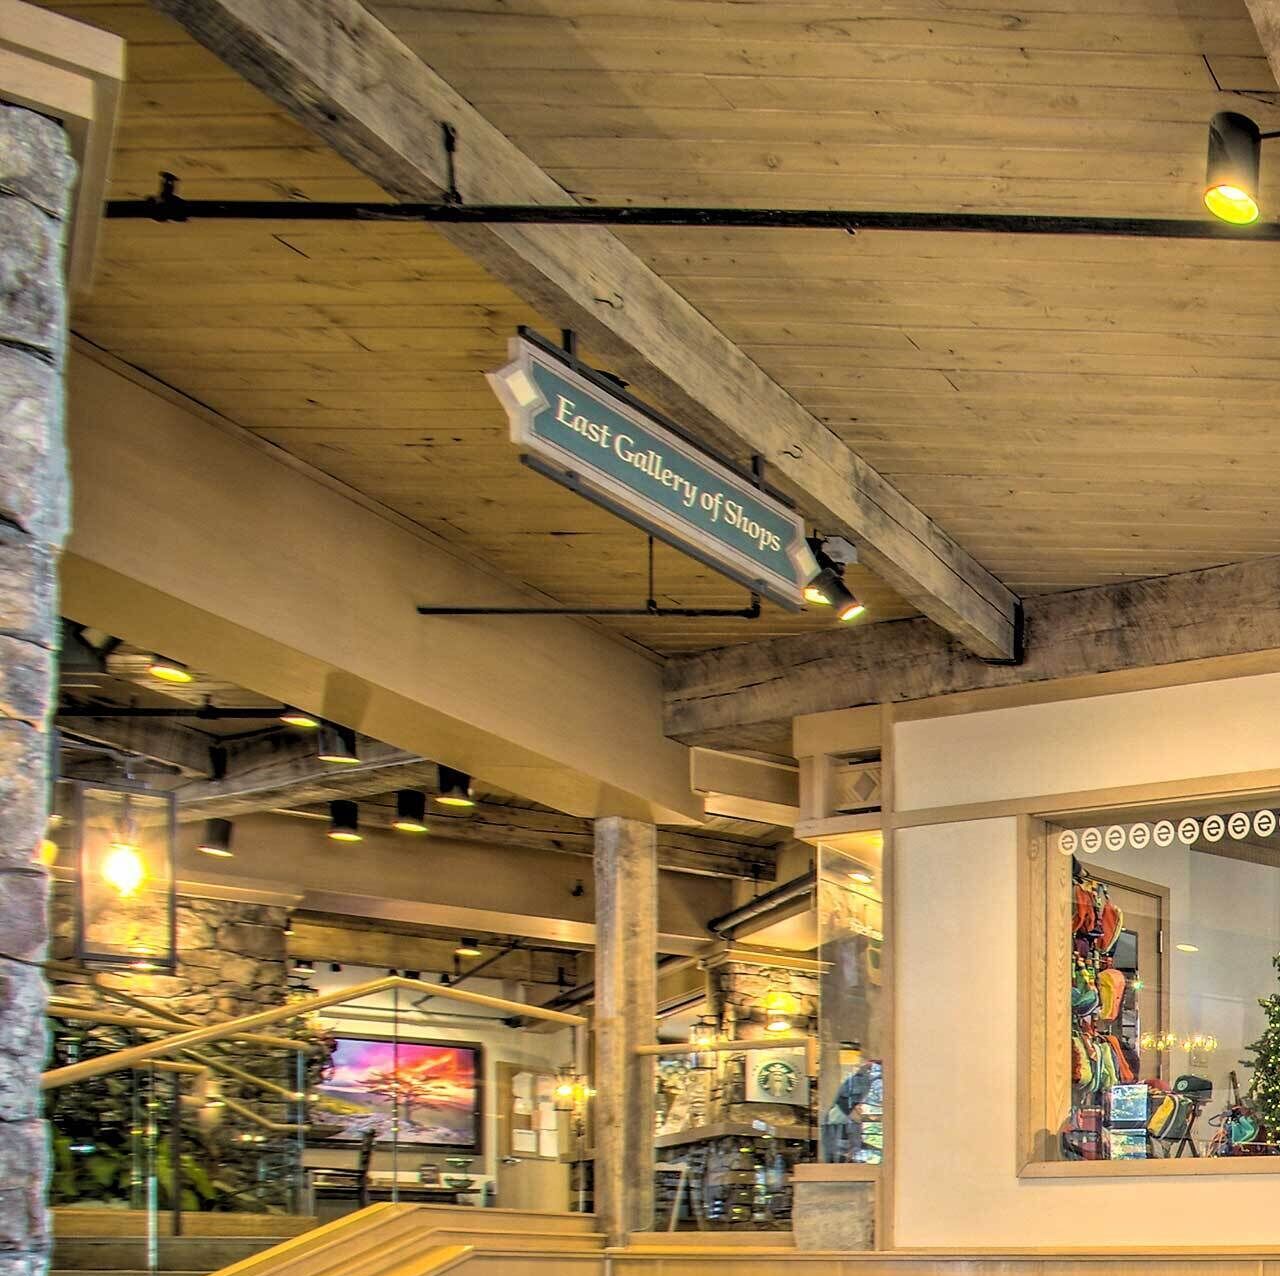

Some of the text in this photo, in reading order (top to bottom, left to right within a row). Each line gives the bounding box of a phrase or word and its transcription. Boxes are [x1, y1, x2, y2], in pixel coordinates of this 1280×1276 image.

[554, 394, 782, 552] East Gallery of Shops
